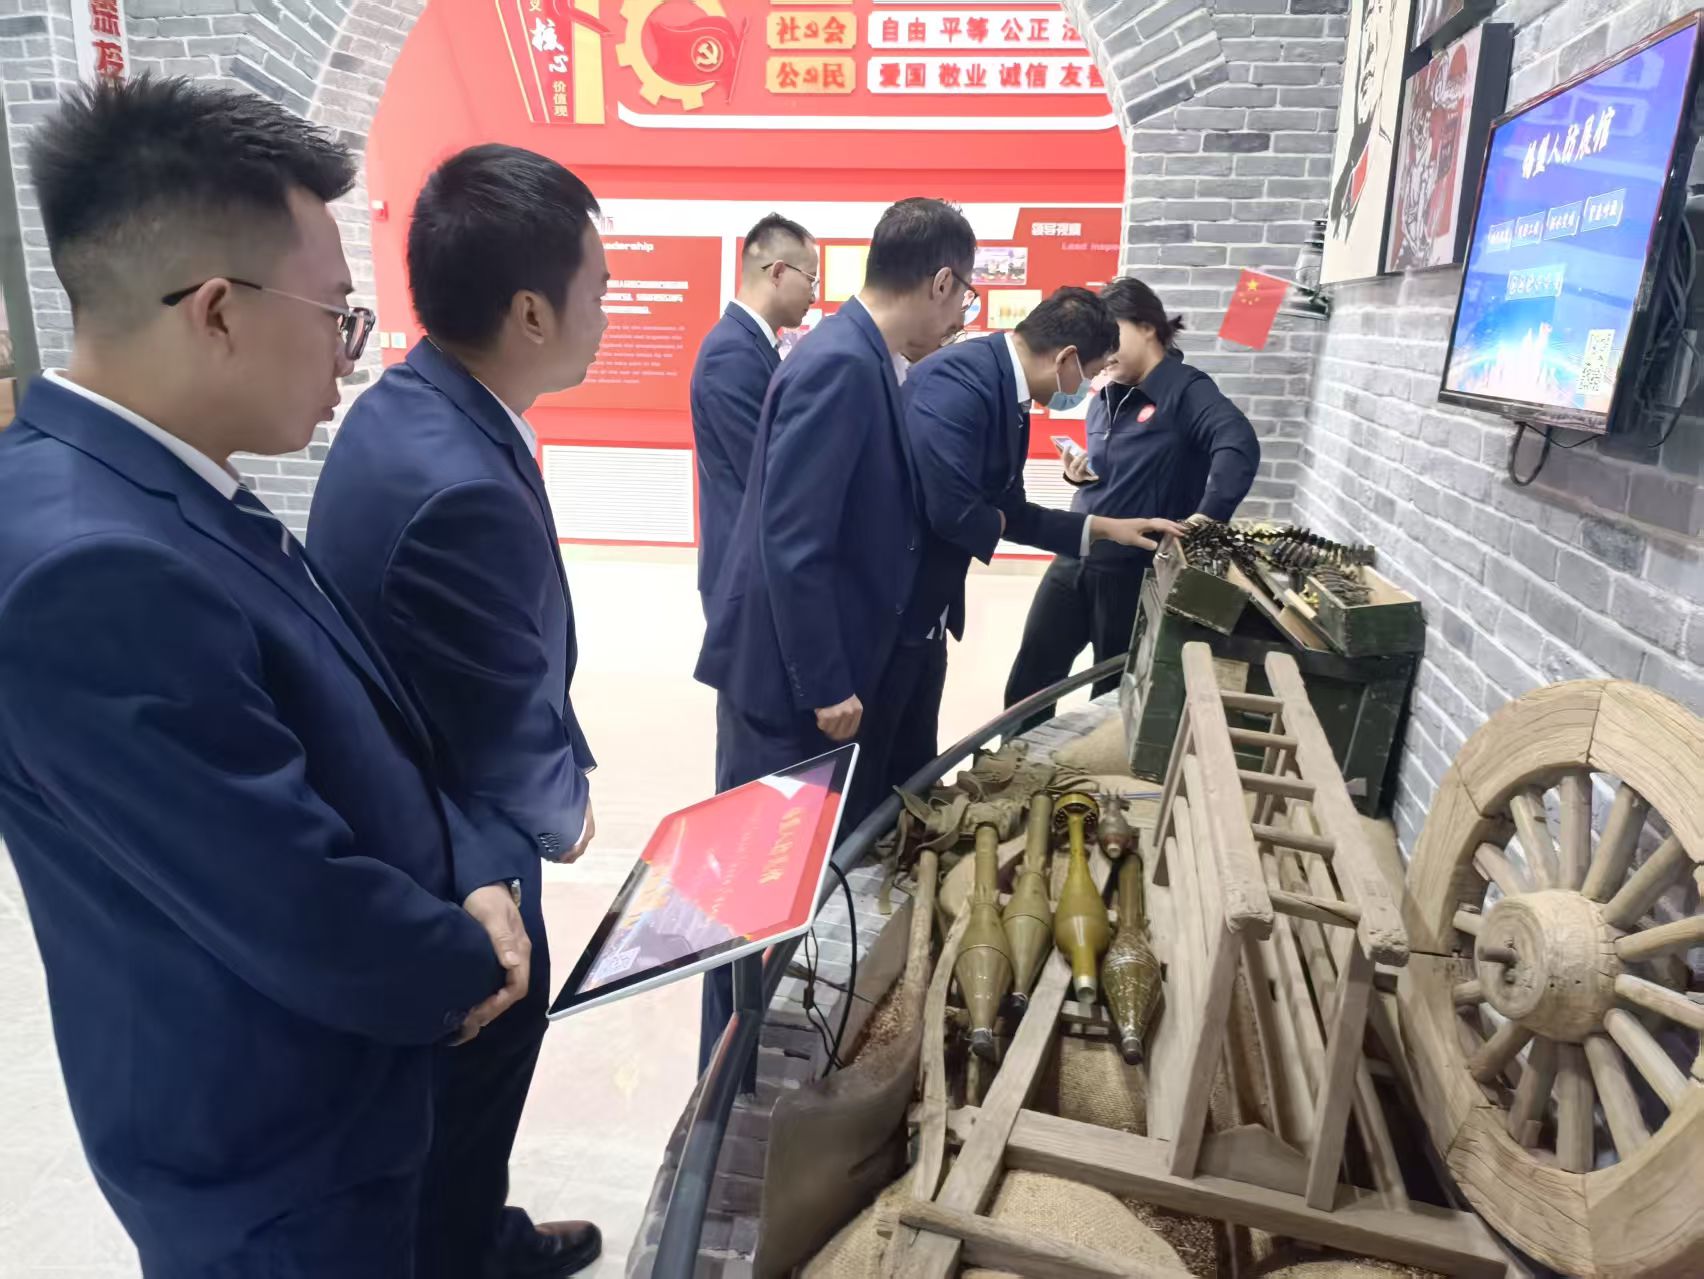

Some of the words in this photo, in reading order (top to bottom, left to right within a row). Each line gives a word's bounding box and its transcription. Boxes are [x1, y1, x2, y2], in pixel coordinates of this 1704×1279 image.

[776, 16, 846, 44] 社会
[882, 17, 926, 43] 自由
[940, 17, 989, 43] 平等
[1000, 17, 1050, 42] 公正
[776, 61, 845, 88] 公民
[879, 63, 926, 88] 爱国
[938, 63, 987, 88] 敬业
[999, 62, 1048, 88] 诚信
